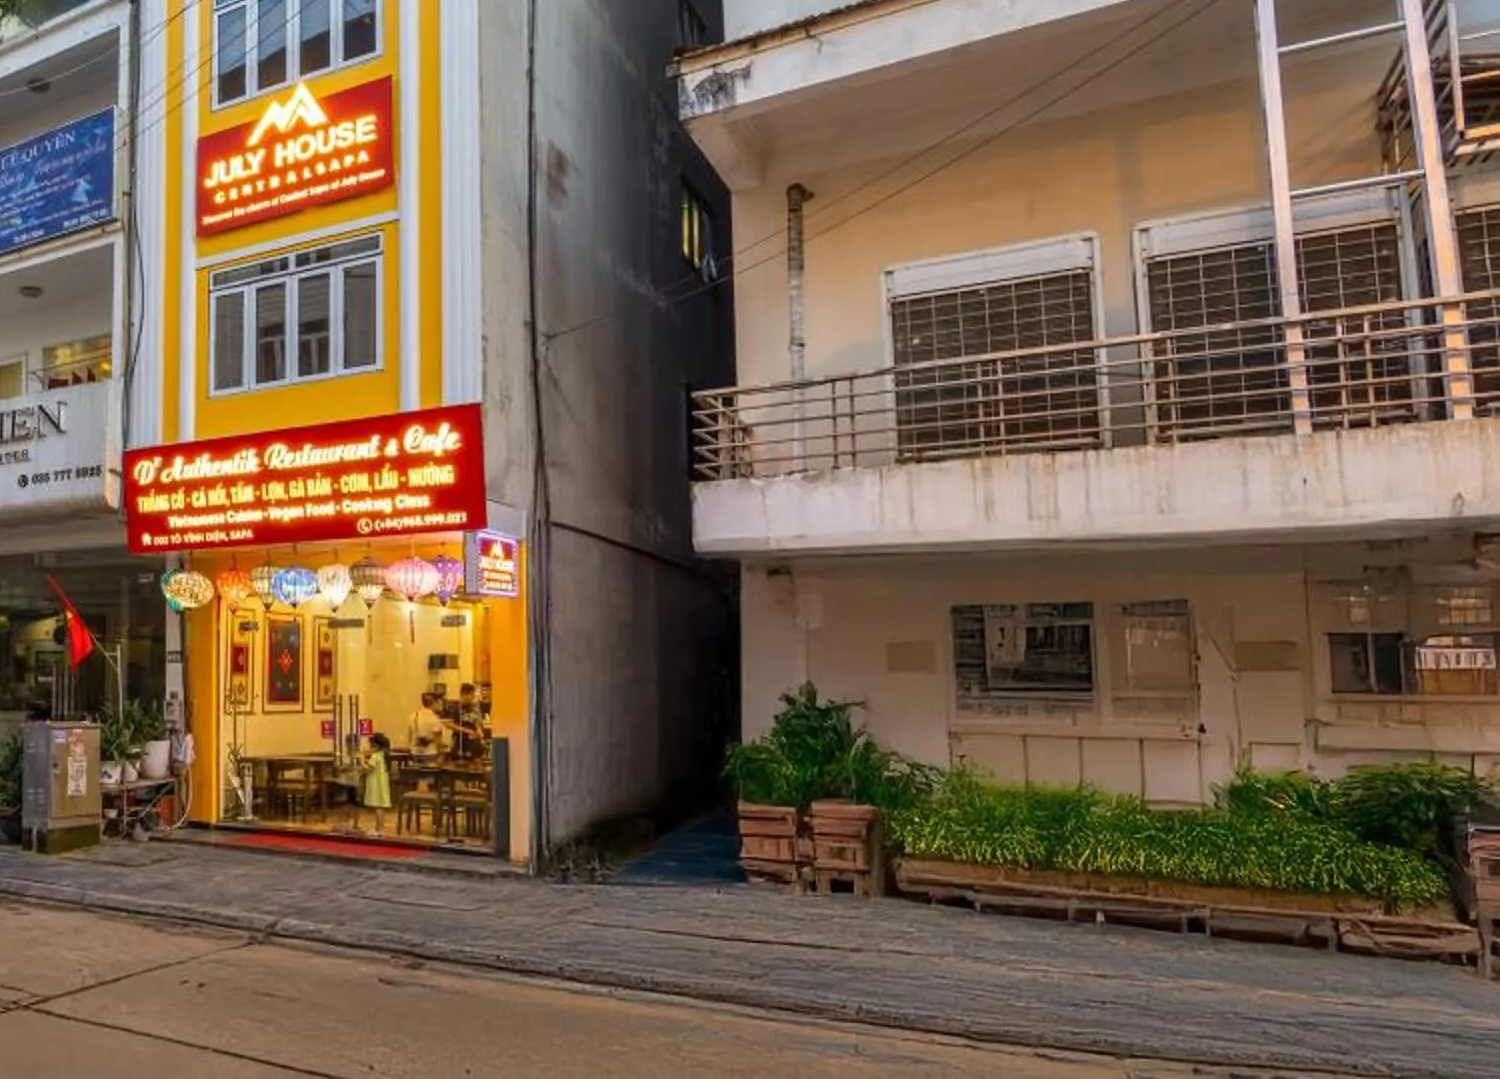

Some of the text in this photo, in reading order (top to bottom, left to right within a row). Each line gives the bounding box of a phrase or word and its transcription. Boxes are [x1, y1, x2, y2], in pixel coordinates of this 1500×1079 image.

[204, 114, 377, 188] JULY HOUSE
[263, 434, 381, 470] Restaurant
[404, 422, 462, 457] Cafe
